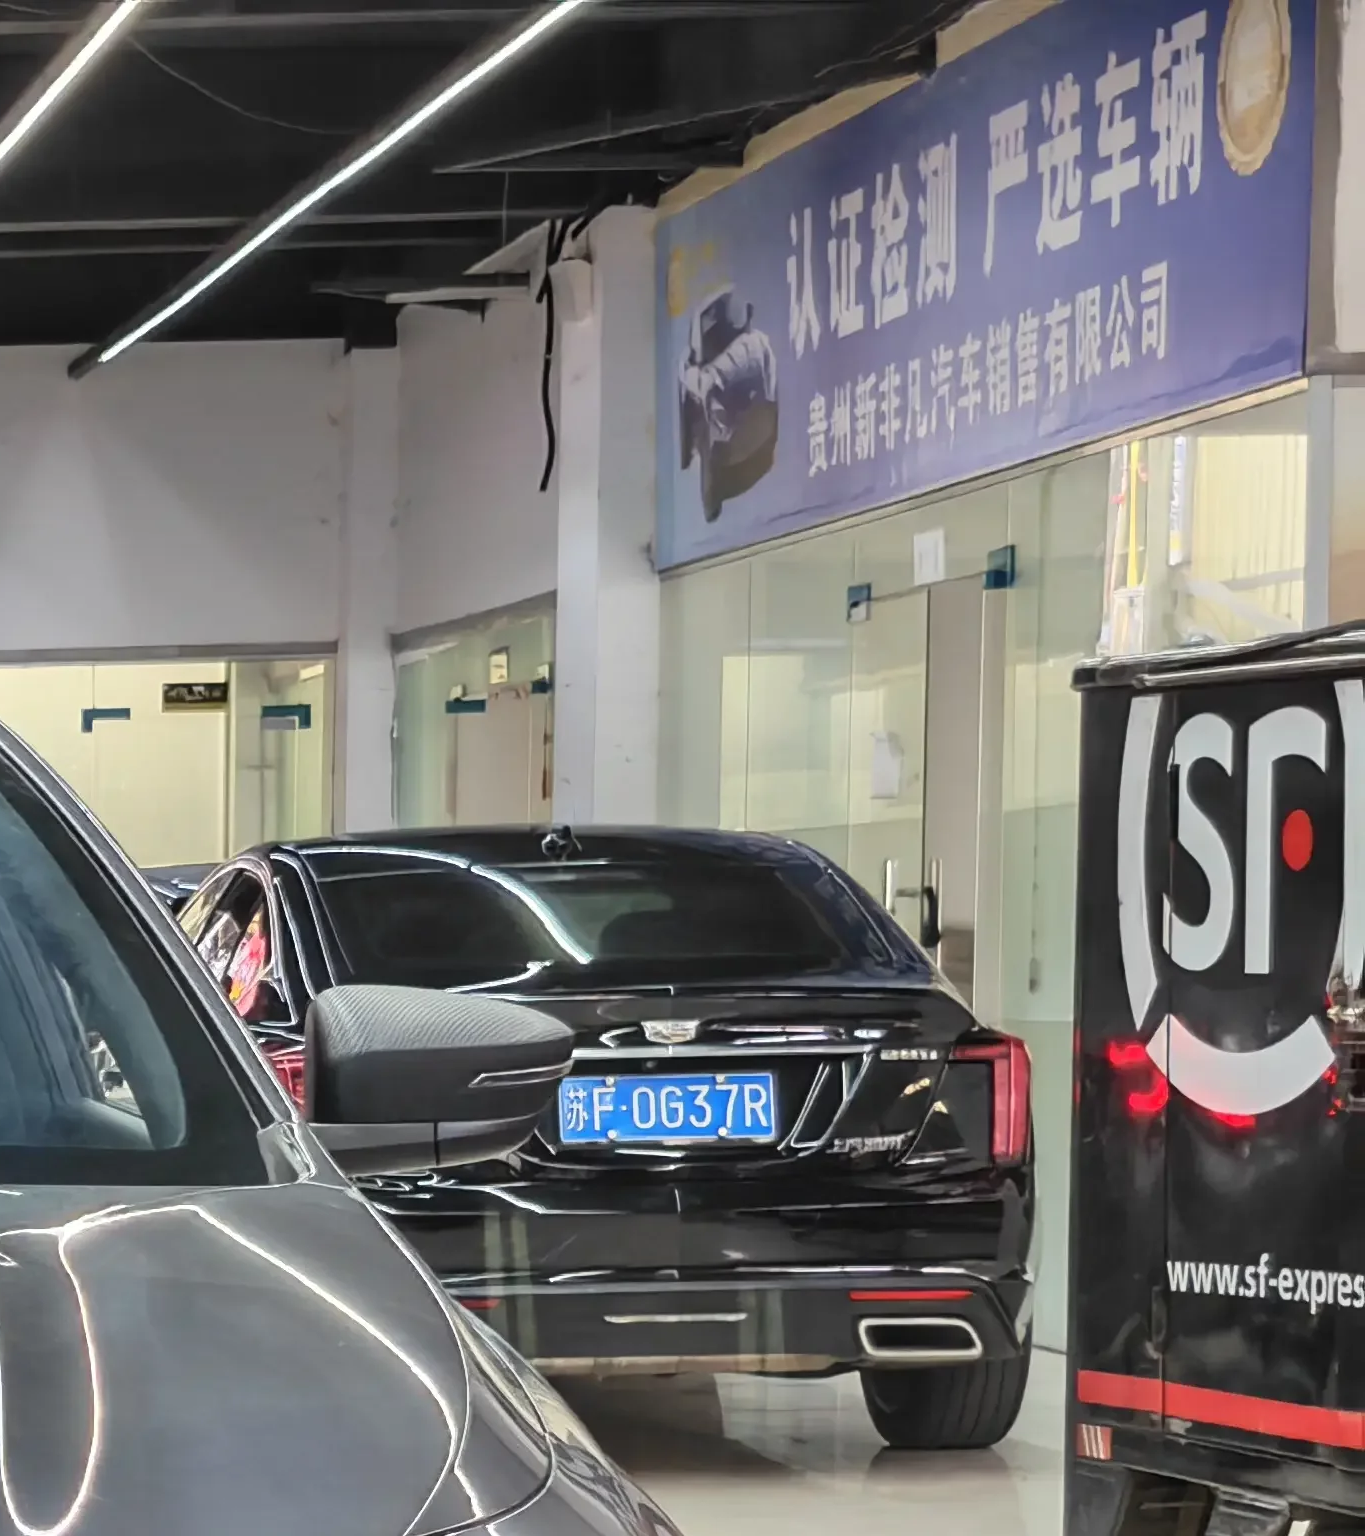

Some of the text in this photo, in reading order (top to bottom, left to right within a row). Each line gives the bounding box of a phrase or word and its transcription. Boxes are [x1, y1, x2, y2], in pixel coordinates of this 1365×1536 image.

[786, 9, 1207, 361] 认证检测 严选车辆
[806, 260, 1169, 478] 贵州新非凡汽车销售有限公司
